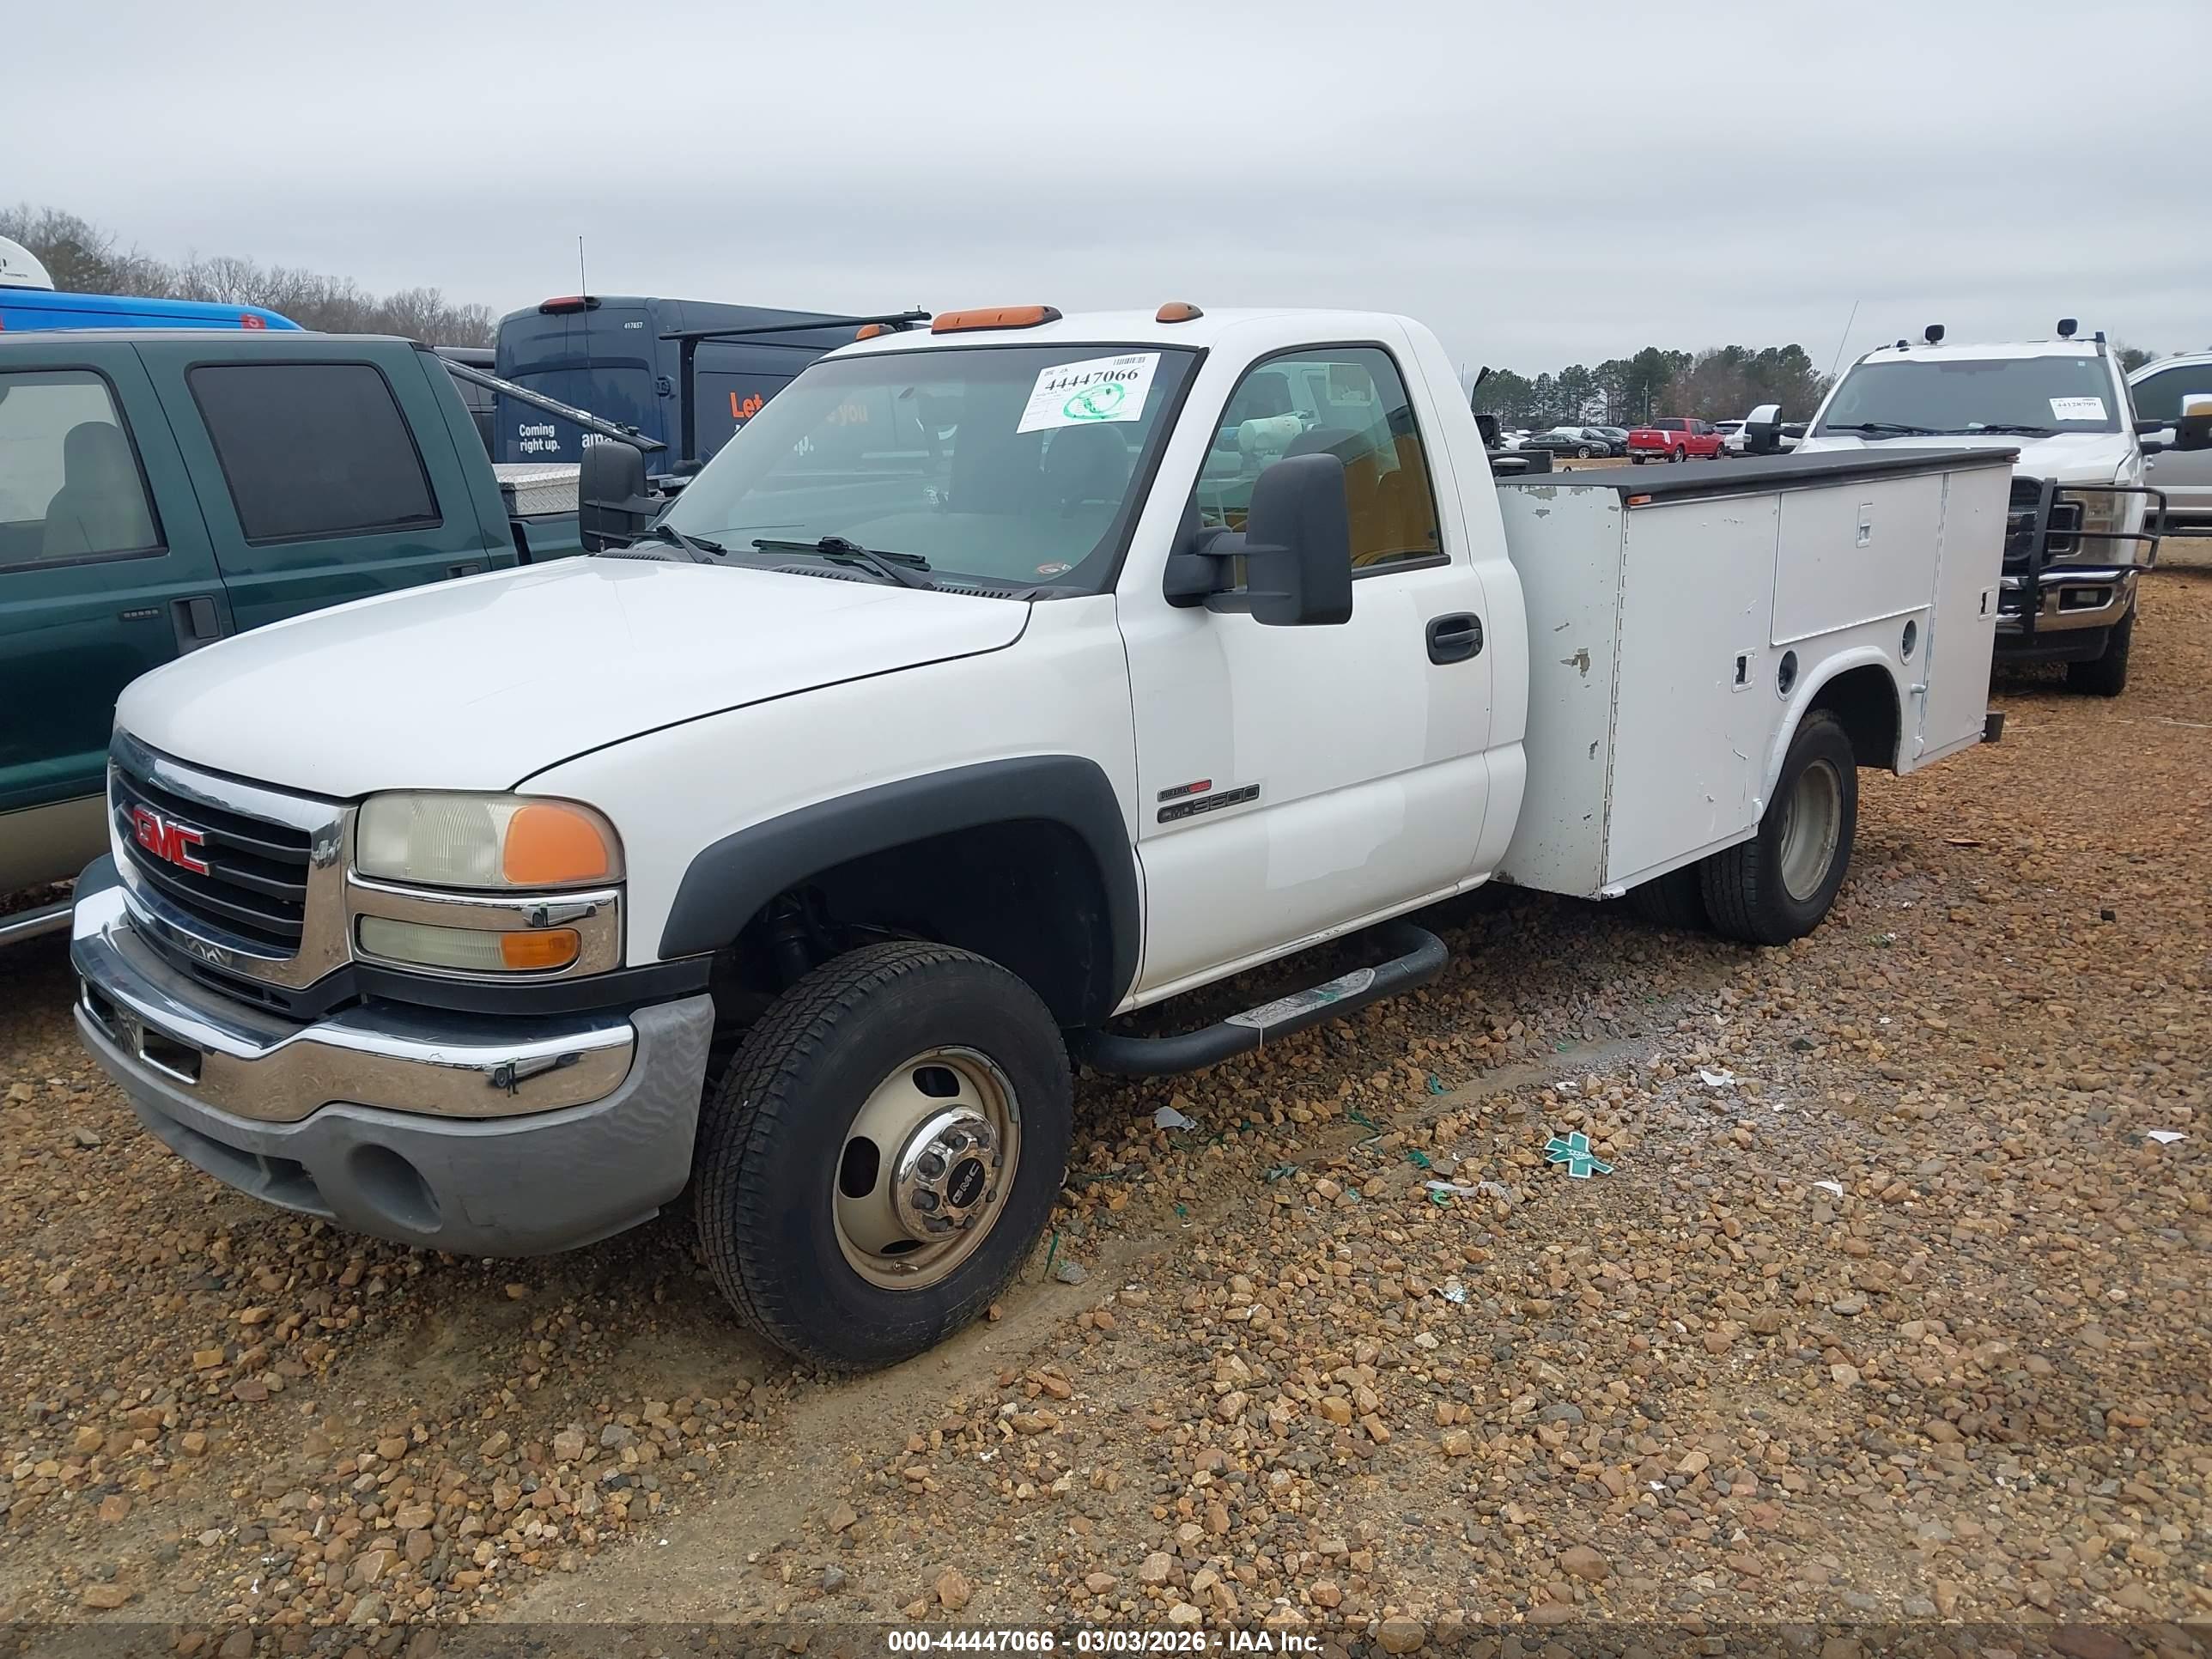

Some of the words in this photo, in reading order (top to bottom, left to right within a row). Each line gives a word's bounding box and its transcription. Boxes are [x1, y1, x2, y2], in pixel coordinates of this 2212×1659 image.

[1045, 368, 1139, 391] 44447066
[730, 392, 763, 418] Let
[519, 422, 555, 437] Coming
[520, 438, 543, 453] right
[544, 439, 561, 453] up.
[1193, 784, 1260, 814] 3500
[134, 804, 210, 876] GMC
[952, 1162, 980, 1203] GMC
